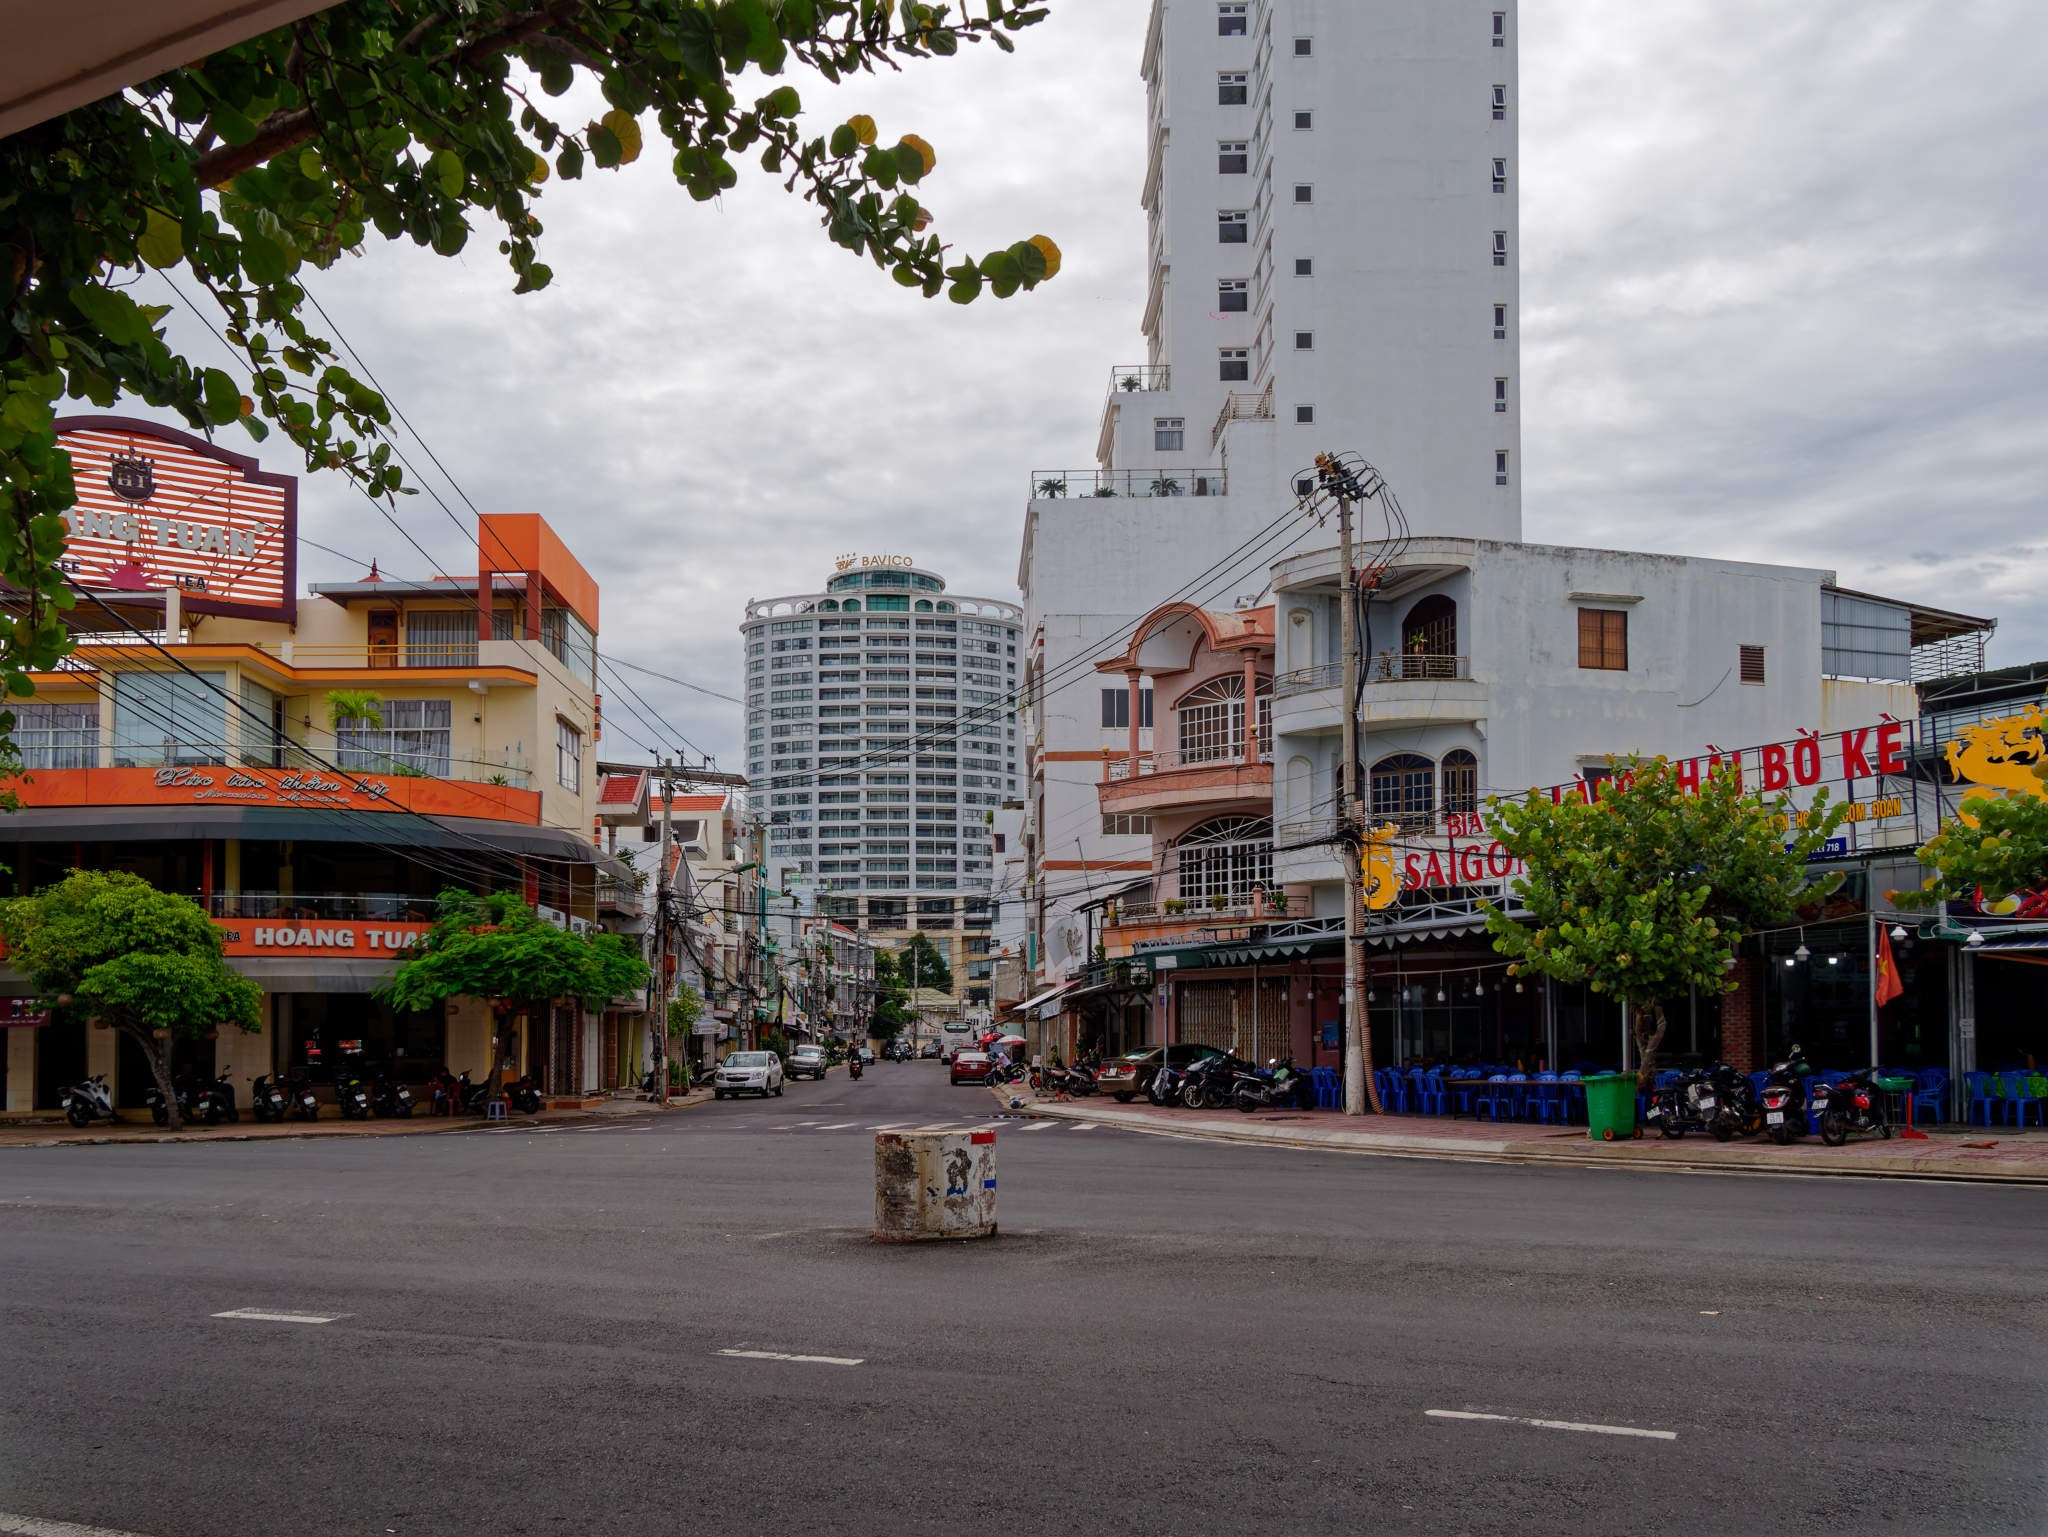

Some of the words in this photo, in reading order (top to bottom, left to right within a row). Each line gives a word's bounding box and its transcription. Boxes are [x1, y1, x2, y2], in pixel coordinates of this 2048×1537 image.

[149, 517, 256, 557] TUAN
[862, 555, 912, 567] BAVICO
[174, 573, 207, 590] TEA
[1762, 727, 1822, 791] BỜ
[1842, 712, 1907, 780] KÈ
[1447, 811, 1484, 839] BIA
[1826, 842, 1840, 852] 718
[254, 926, 355, 949] HOANG
